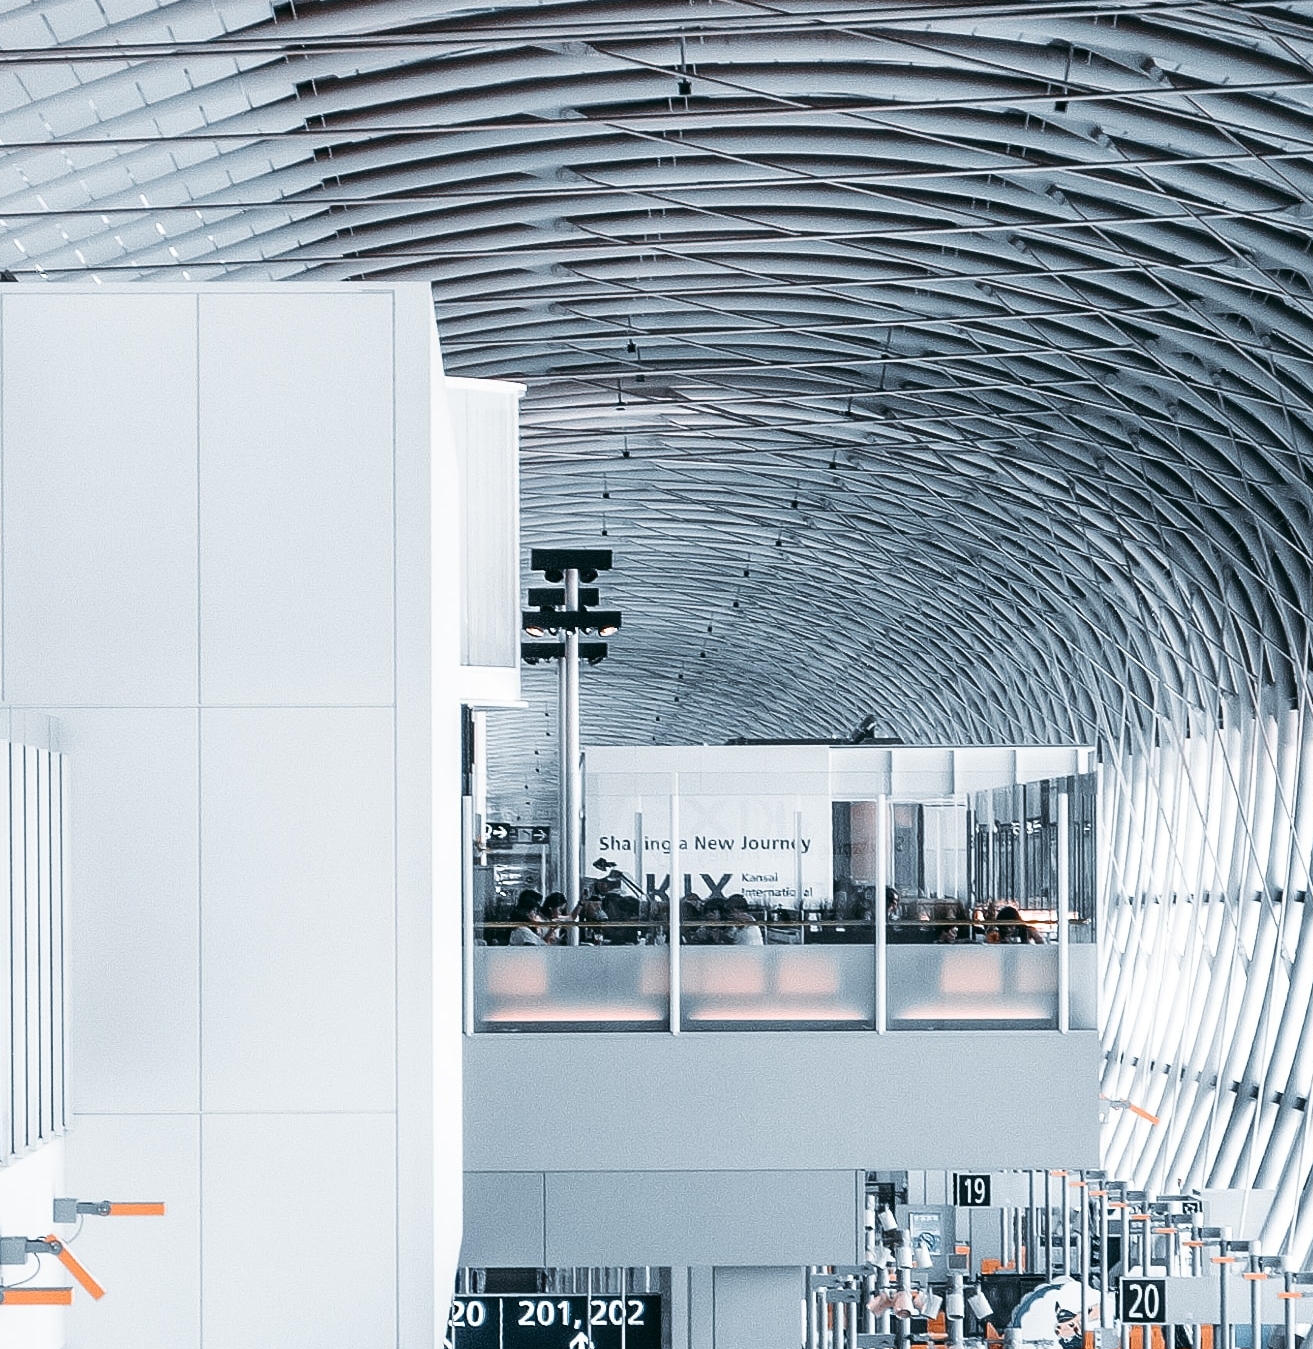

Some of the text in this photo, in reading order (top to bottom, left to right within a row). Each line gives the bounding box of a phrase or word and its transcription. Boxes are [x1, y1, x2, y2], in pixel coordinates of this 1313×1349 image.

[599, 836, 670, 853] Shaing
[679, 839, 688, 850] a
[694, 836, 734, 850] New
[741, 873, 778, 882] Kansai
[741, 887, 812, 897] Internatioal
[964, 1177, 986, 1204] 19
[1128, 1283, 1160, 1319] 20
[518, 1300, 645, 1329] 201, 202
